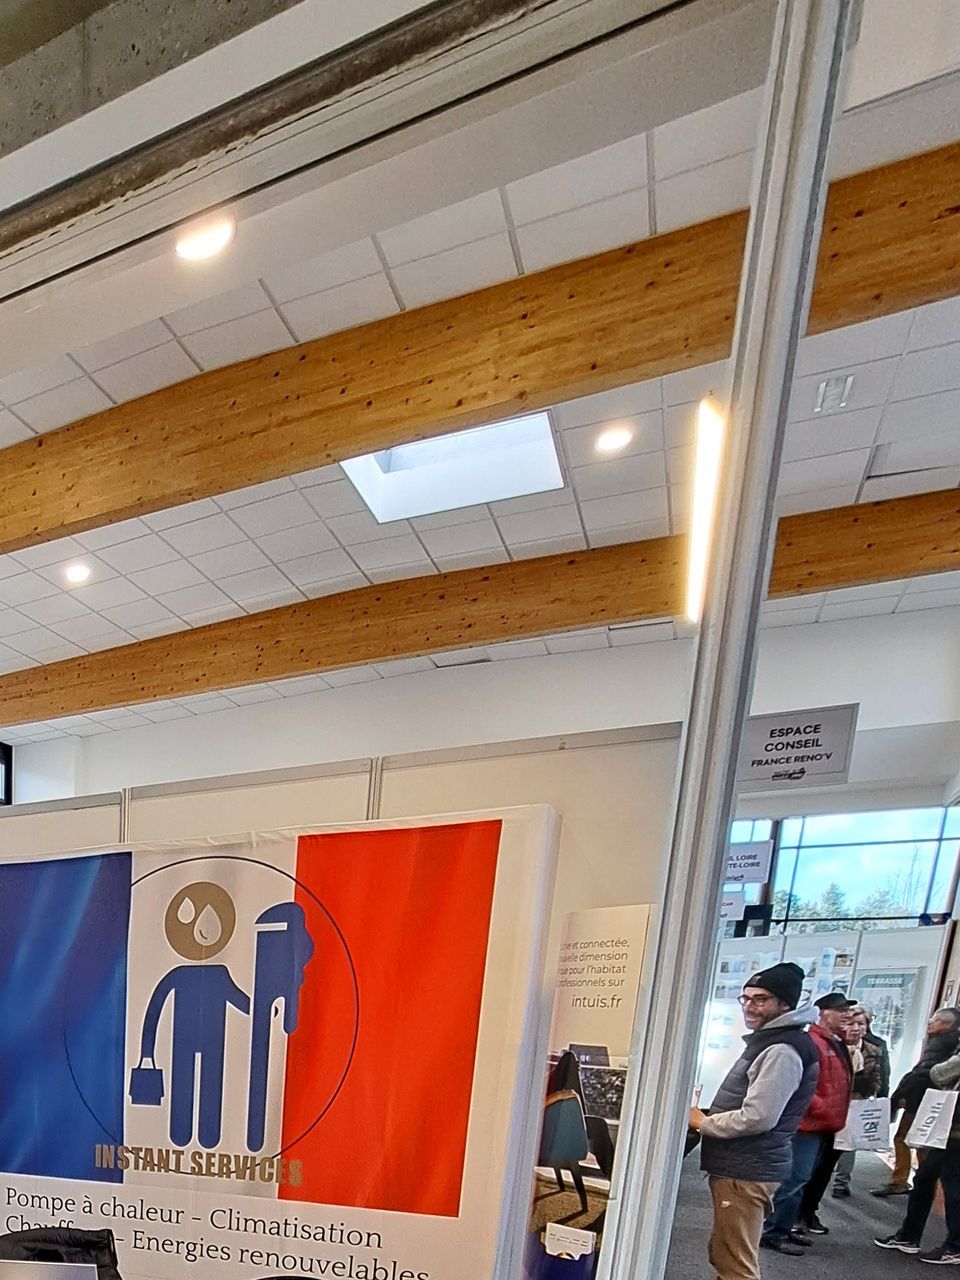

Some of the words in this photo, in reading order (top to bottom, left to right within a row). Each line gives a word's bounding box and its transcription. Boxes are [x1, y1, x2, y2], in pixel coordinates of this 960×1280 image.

[770, 724, 822, 738] ESPACE
[764, 738, 823, 752] CONSEIL
[751, 757, 792, 767] FRANCE
[728, 861, 761, 869] TE-LOIRE
[580, 938, 630, 949] connectée,
[579, 951, 628, 962] dimension
[586, 964, 626, 974] l'habitat
[608, 979, 624, 987] sur
[571, 994, 622, 1008] intuis.fr
[95, 1144, 185, 1173] INSTANT
[190, 1150, 303, 1186] SERVICES
[5, 1187, 76, 1216] Pompe
[82, 1195, 93, 1214] à
[99, 1196, 185, 1224] chaleur
[210, 1208, 383, 1249] Climatisation
[133, 1230, 231, 1262] Energies
